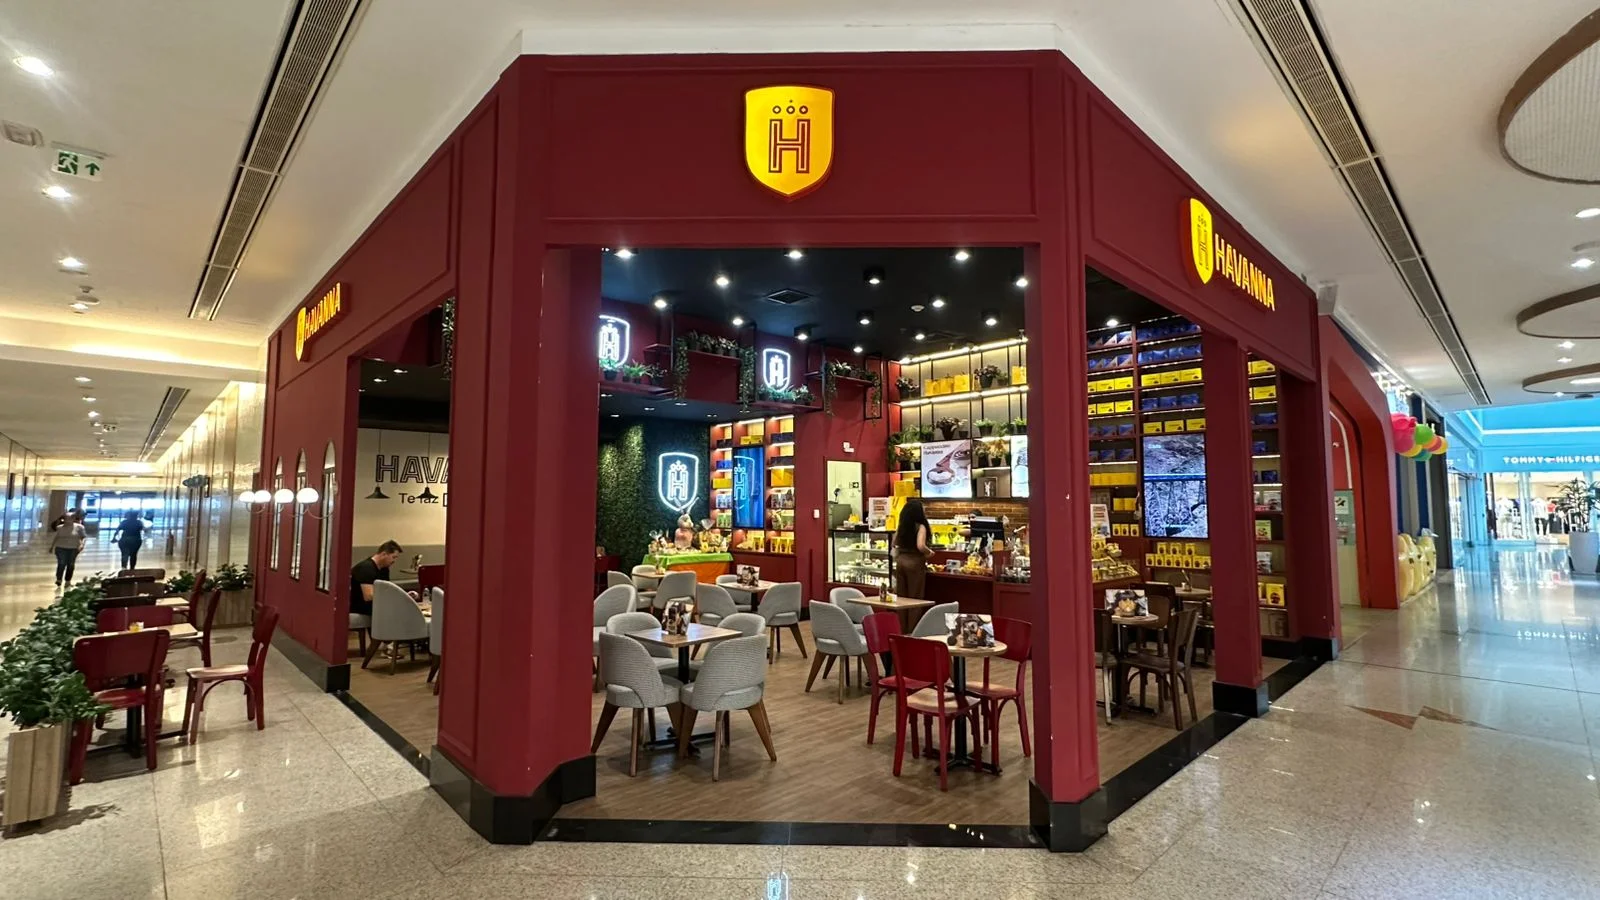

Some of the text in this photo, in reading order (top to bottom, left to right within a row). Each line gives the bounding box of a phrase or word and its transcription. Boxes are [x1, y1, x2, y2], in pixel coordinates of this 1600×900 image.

[769, 119, 810, 173] H
[1214, 233, 1275, 311] HAVANNA
[304, 282, 341, 341] HAVANNA
[1503, 456, 1543, 464] TOMMY
[398, 492, 415, 504] Te
